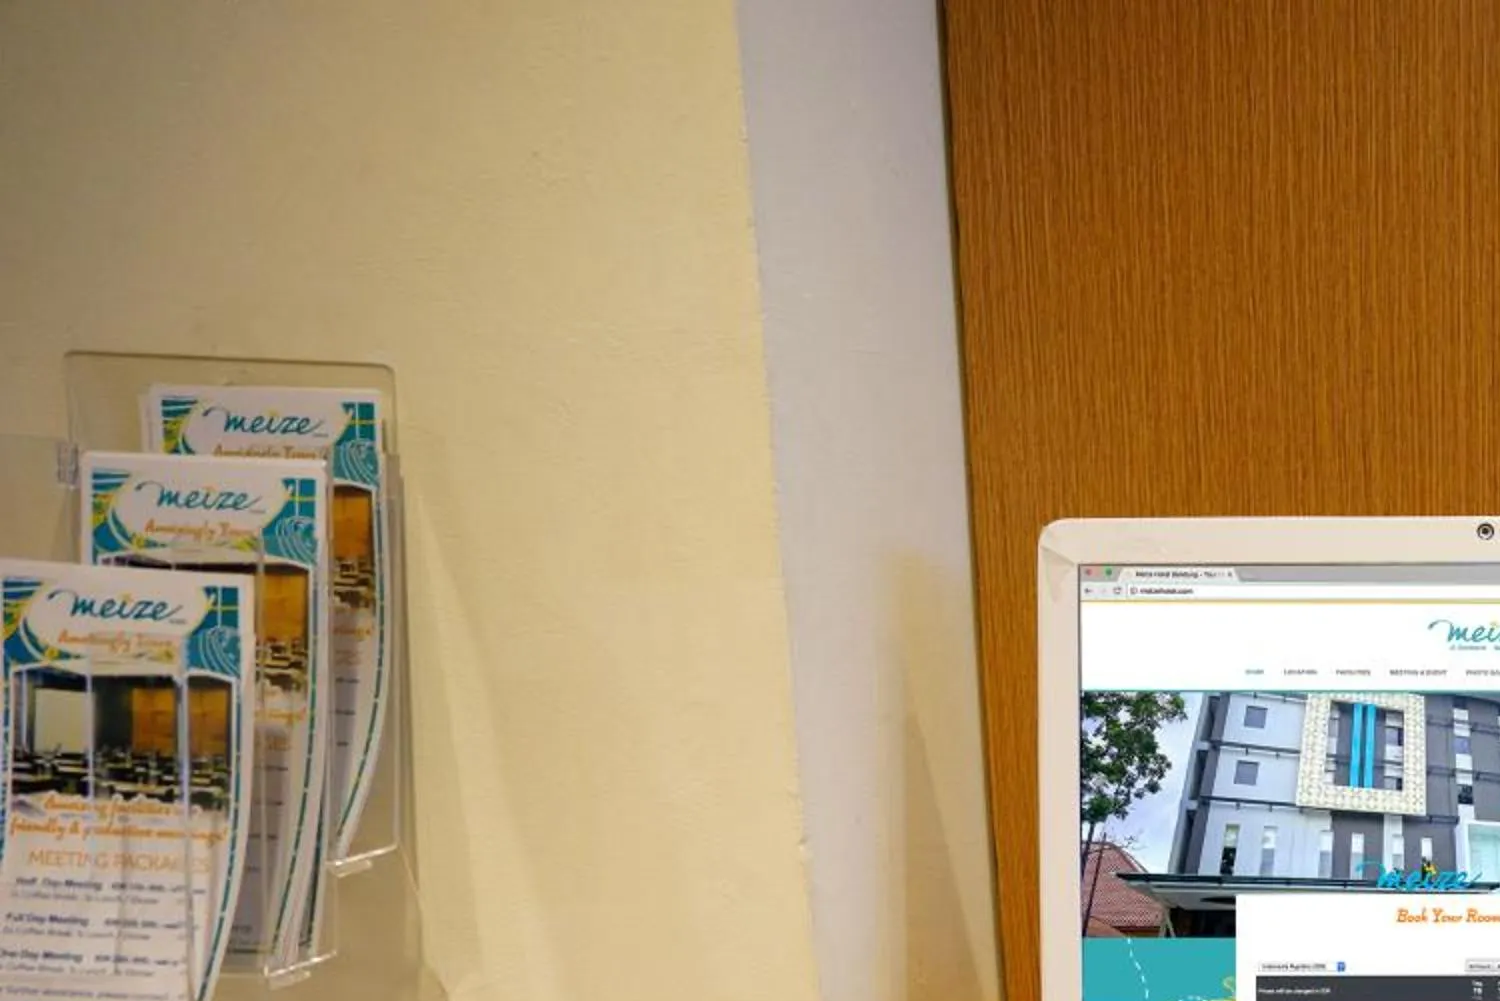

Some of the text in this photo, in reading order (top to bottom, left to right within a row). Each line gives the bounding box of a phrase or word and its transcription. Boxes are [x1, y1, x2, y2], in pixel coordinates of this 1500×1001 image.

[202, 405, 324, 435] meize
[134, 480, 263, 511] meize
[47, 589, 184, 620] meize
[28, 850, 211, 873] MEETING PACKAES
[1396, 907, 1429, 924] Book
[1431, 907, 1463, 924] Your
